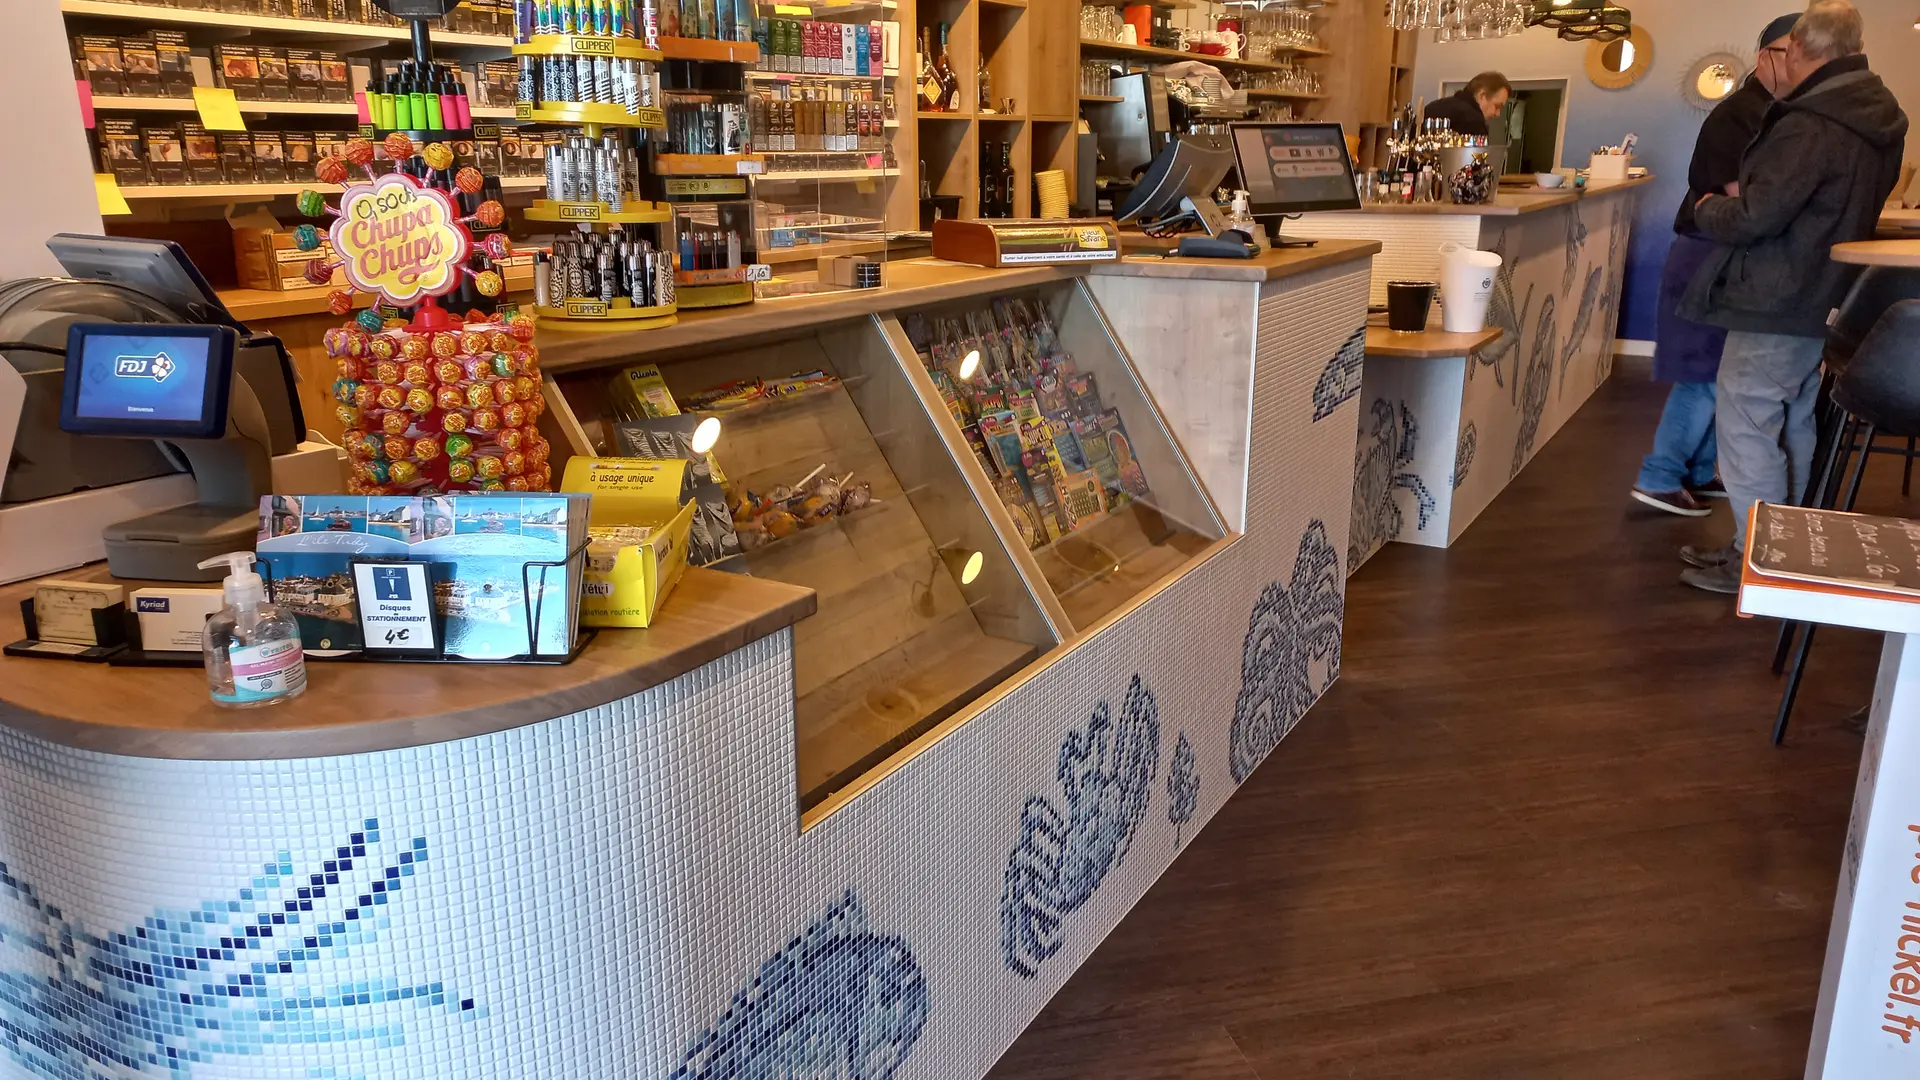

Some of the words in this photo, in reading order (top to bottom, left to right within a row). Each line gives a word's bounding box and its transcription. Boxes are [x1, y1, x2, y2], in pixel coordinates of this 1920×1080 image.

[574, 40, 610, 51] CLIPPER
[561, 208, 598, 218] CLIPPER
[351, 203, 434, 248] Chupa
[1079, 234, 1107, 243] Savane
[359, 230, 444, 285] Chups
[570, 304, 604, 314] CLIPPER
[118, 360, 148, 373] FDJ
[629, 369, 660, 381] Ricola
[127, 405, 154, 413] Bienvenue
[590, 472, 596, 482] à
[599, 474, 624, 485] usage
[627, 472, 655, 485] unique
[139, 599, 166, 610] Kyriad
[379, 604, 412, 612] Disques
[610, 604, 641, 616] routière
[384, 628, 410, 645] 4€
